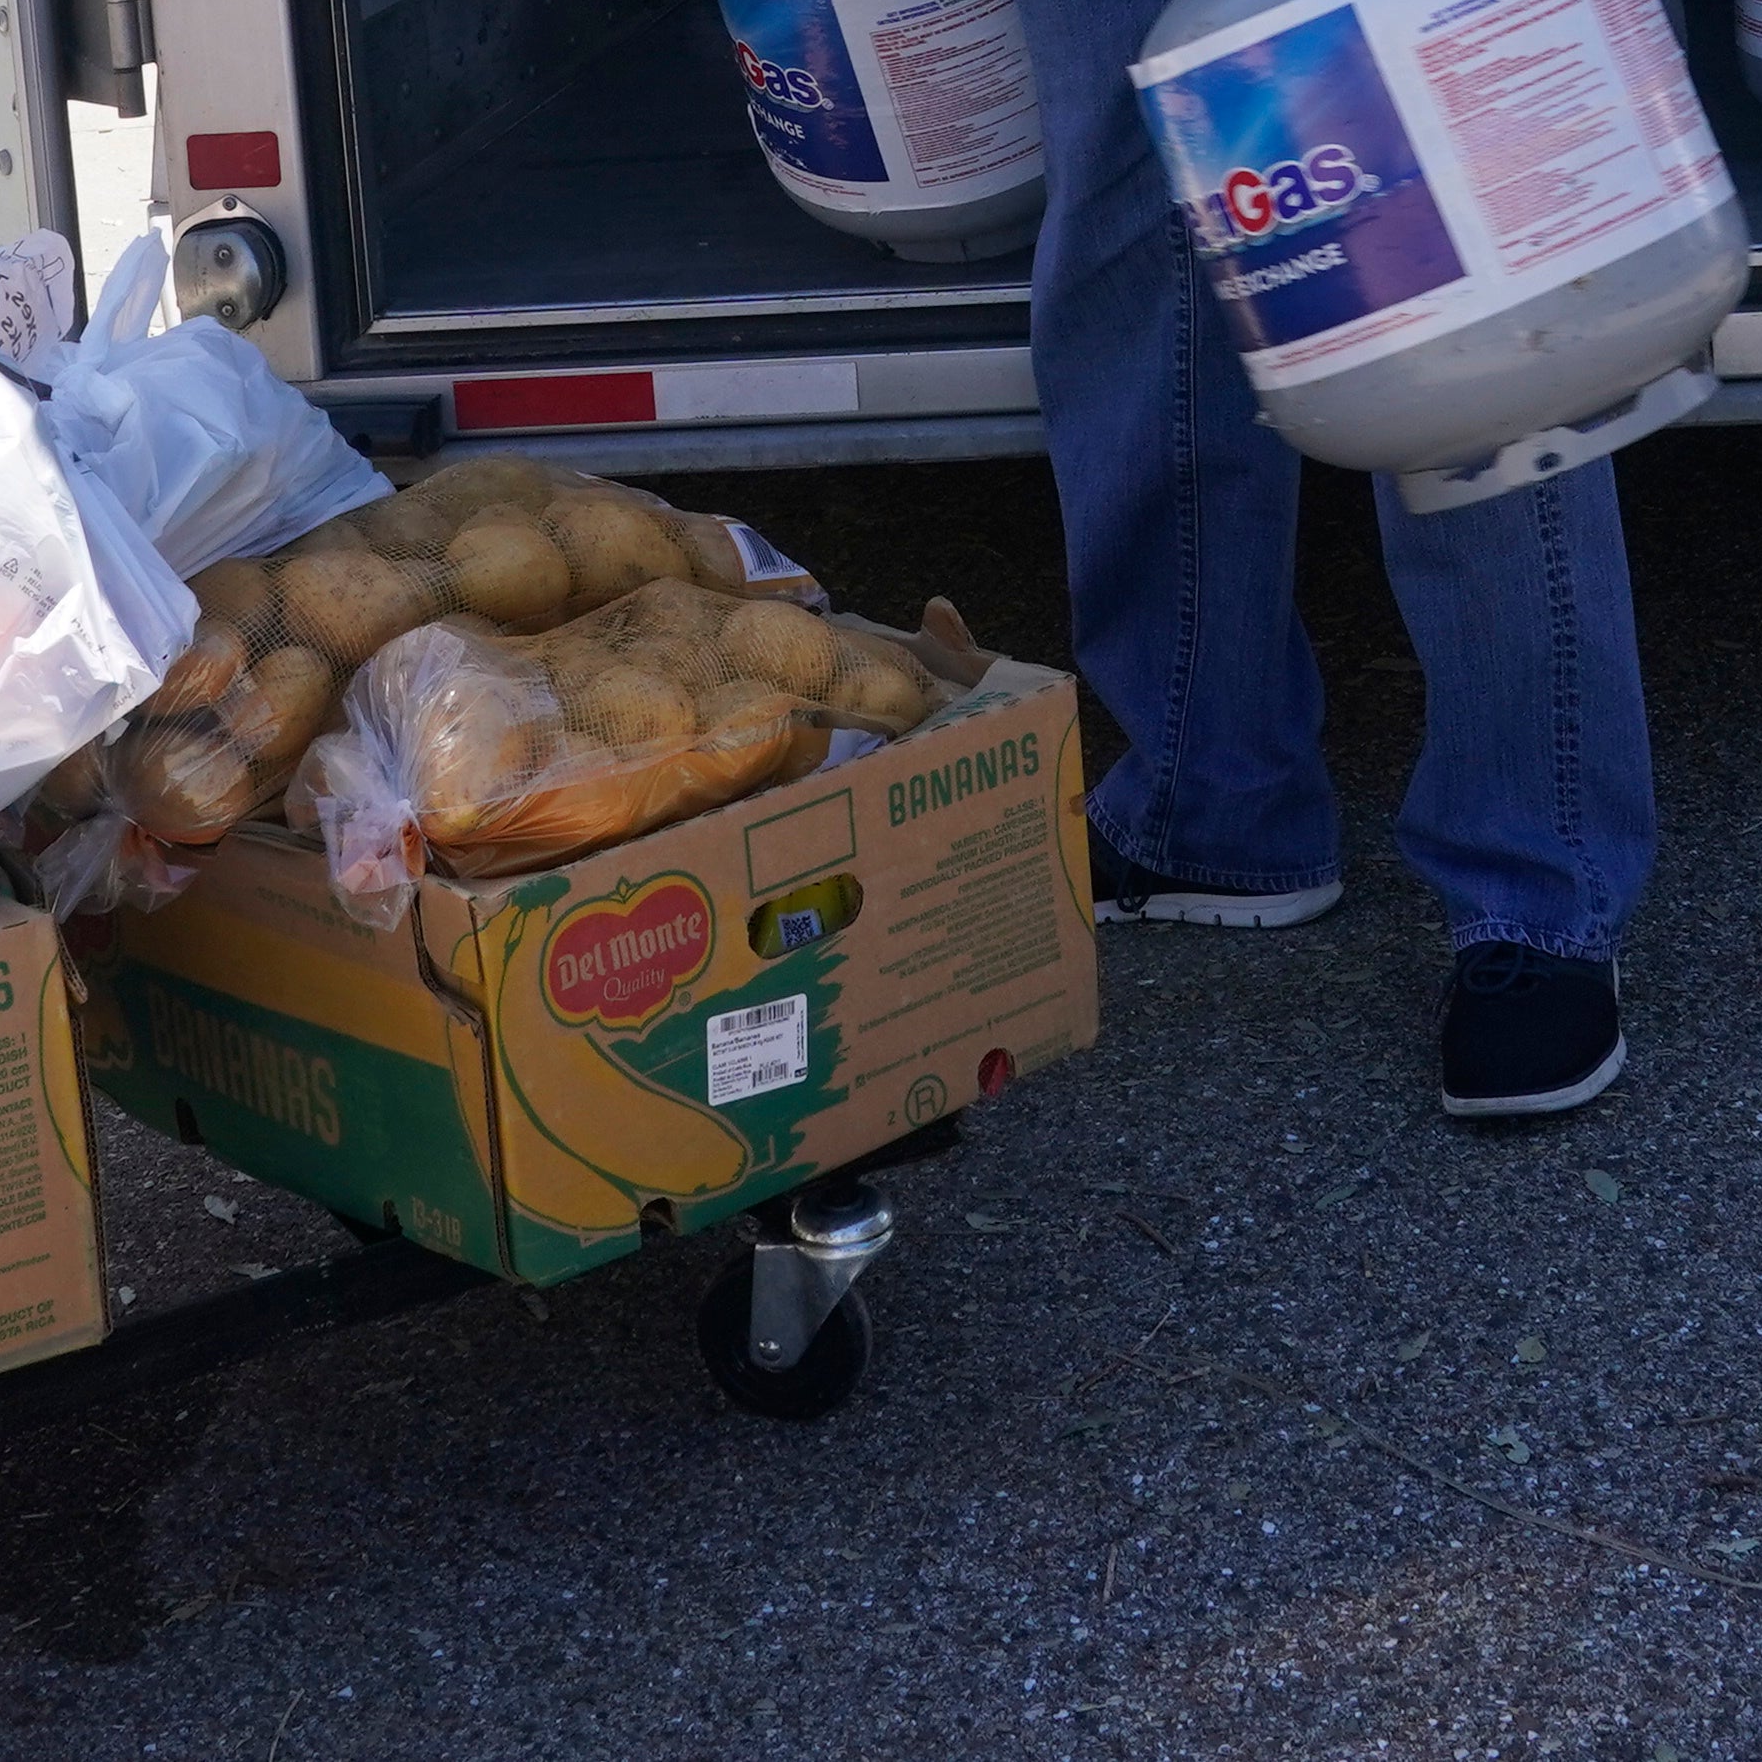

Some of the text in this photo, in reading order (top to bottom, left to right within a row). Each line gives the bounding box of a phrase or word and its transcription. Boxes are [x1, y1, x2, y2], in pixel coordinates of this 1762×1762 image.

[737, 38, 824, 110] Gas
[887, 728, 1039, 831] BANANAS
[557, 901, 703, 992] Del Monte
[602, 957, 666, 1010] Quality
[10, 1062, 30, 1077] cm
[147, 985, 341, 1149] BANANAS
[20, 1311, 57, 1335] RICA
[36, 1297, 55, 1315] OF
